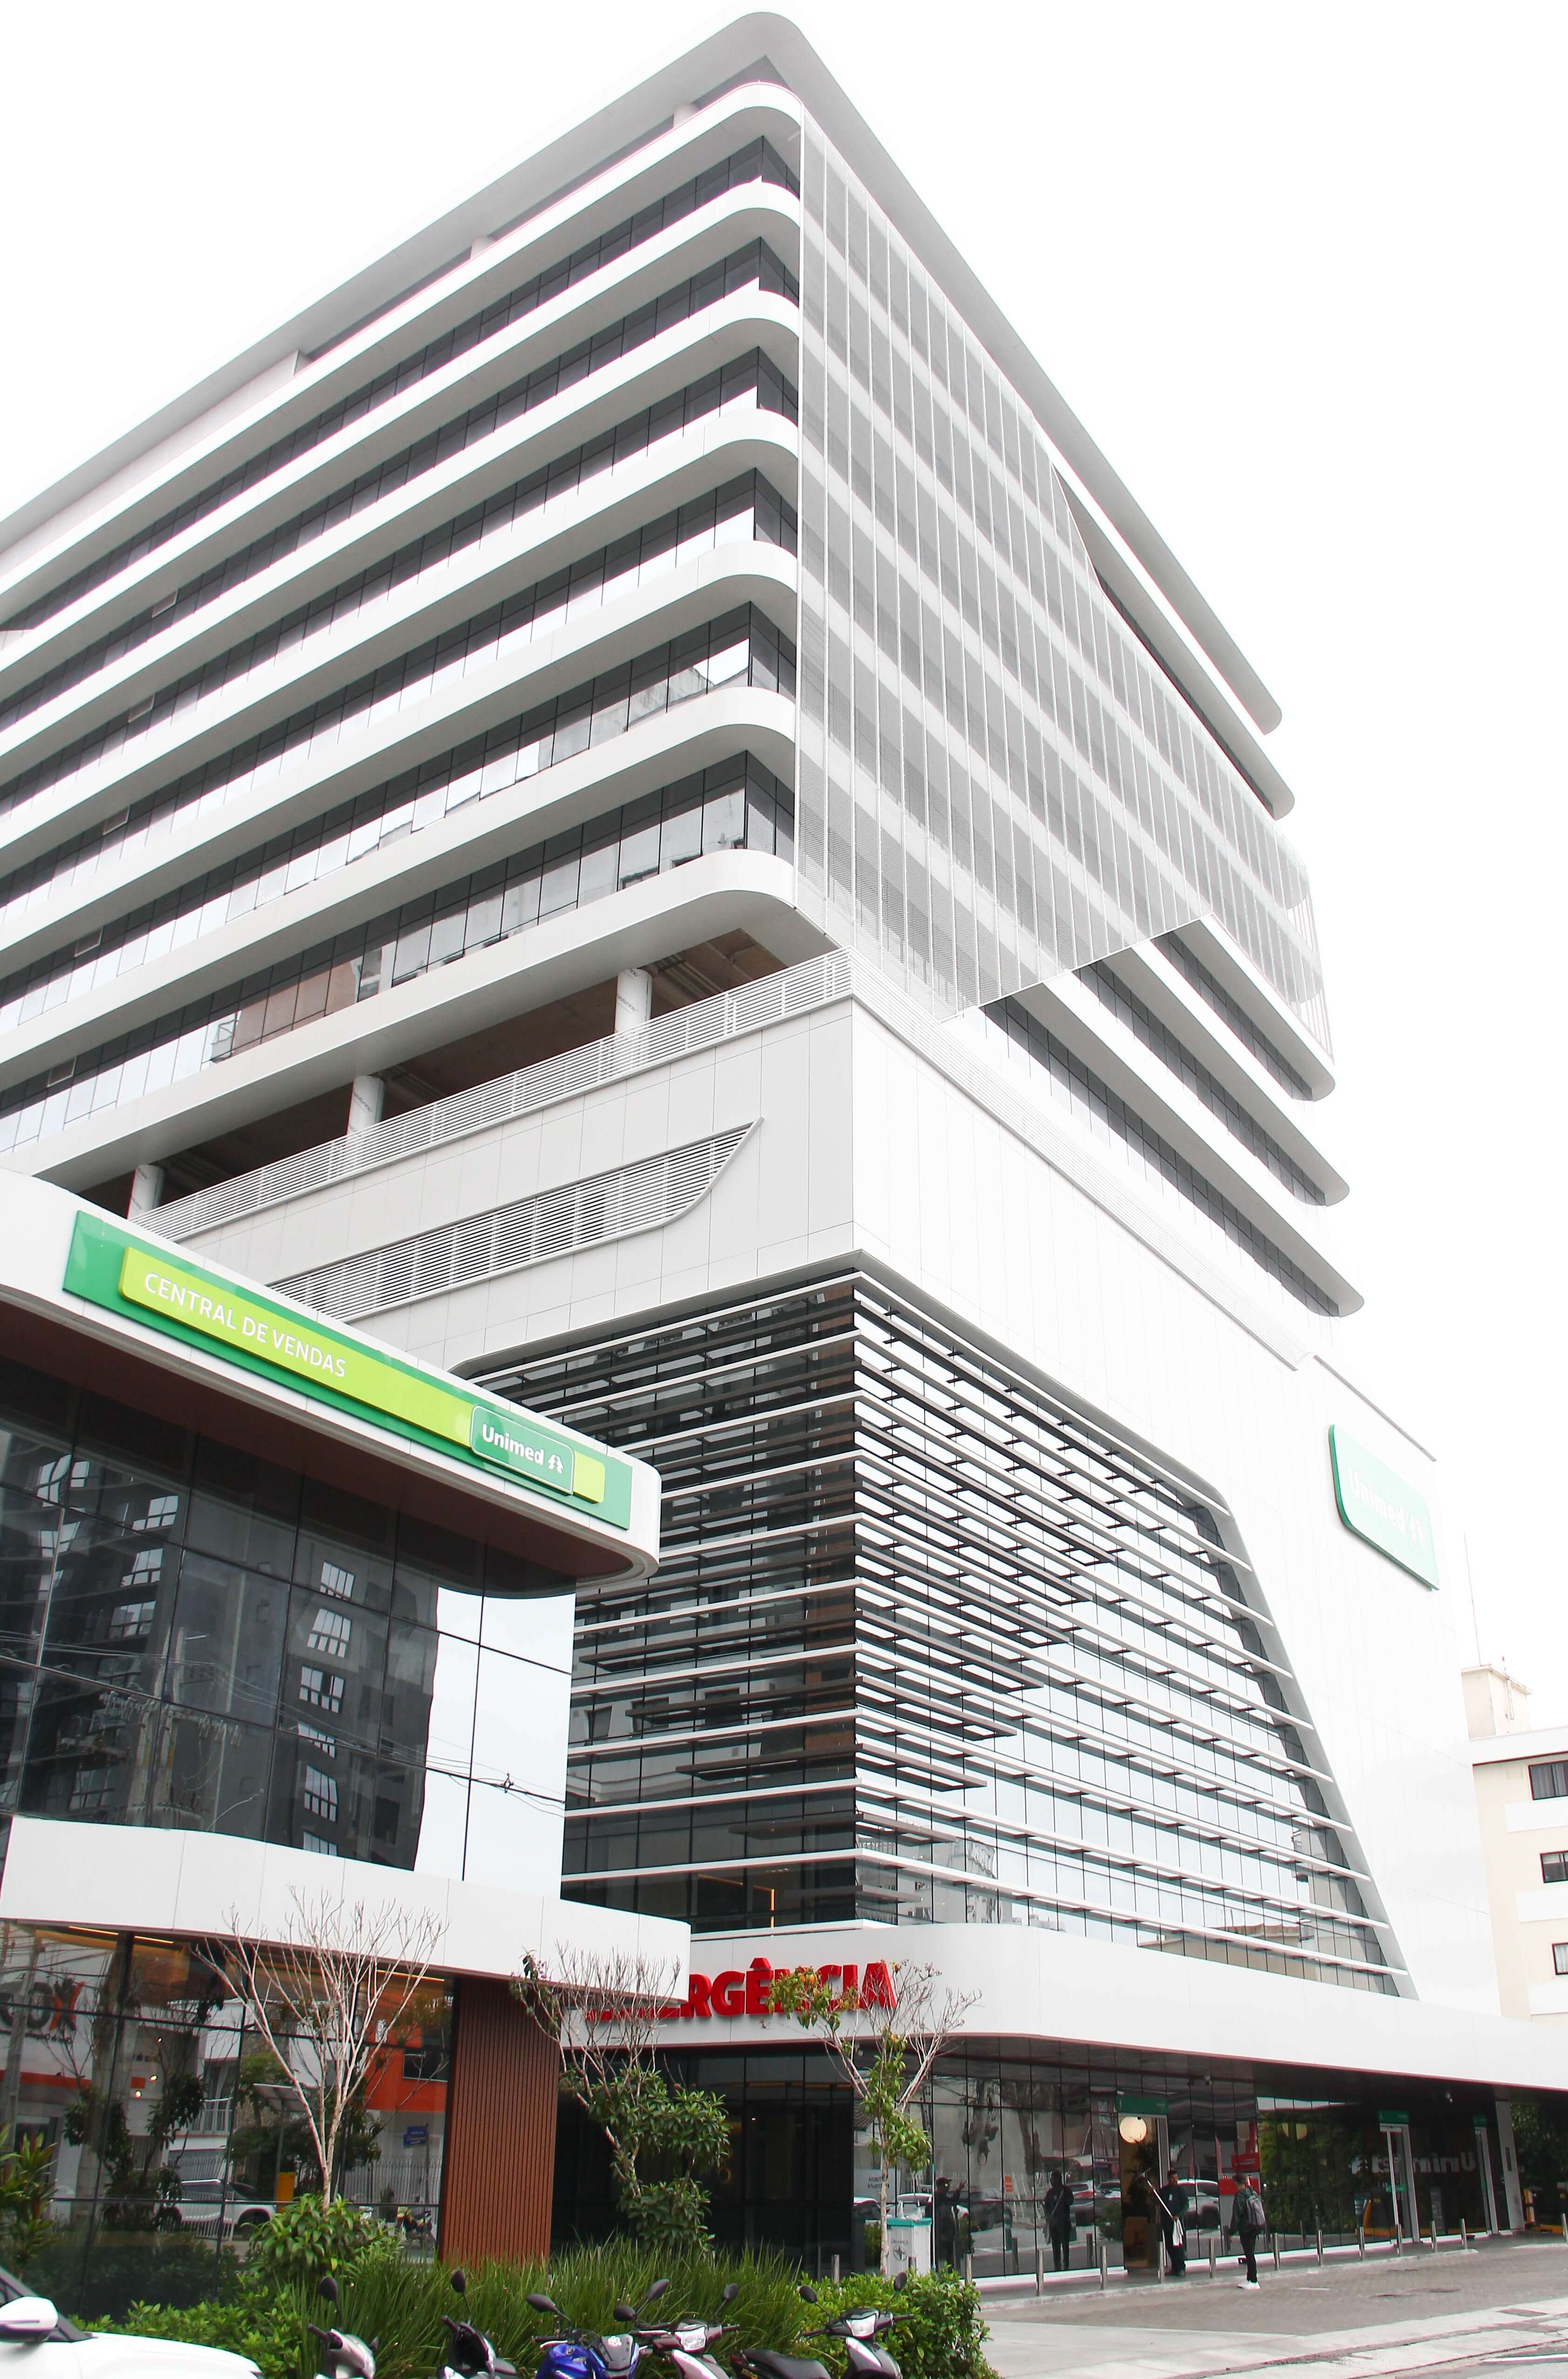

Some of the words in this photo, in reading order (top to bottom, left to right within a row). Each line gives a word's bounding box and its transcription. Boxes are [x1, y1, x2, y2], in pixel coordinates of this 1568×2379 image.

[145, 1273, 237, 1330] CENTRAL
[242, 1316, 268, 1343] DE
[273, 1329, 346, 1378] VENDAS
[482, 1424, 544, 1466] Unimed
[1349, 1466, 1405, 1533] Unimed
